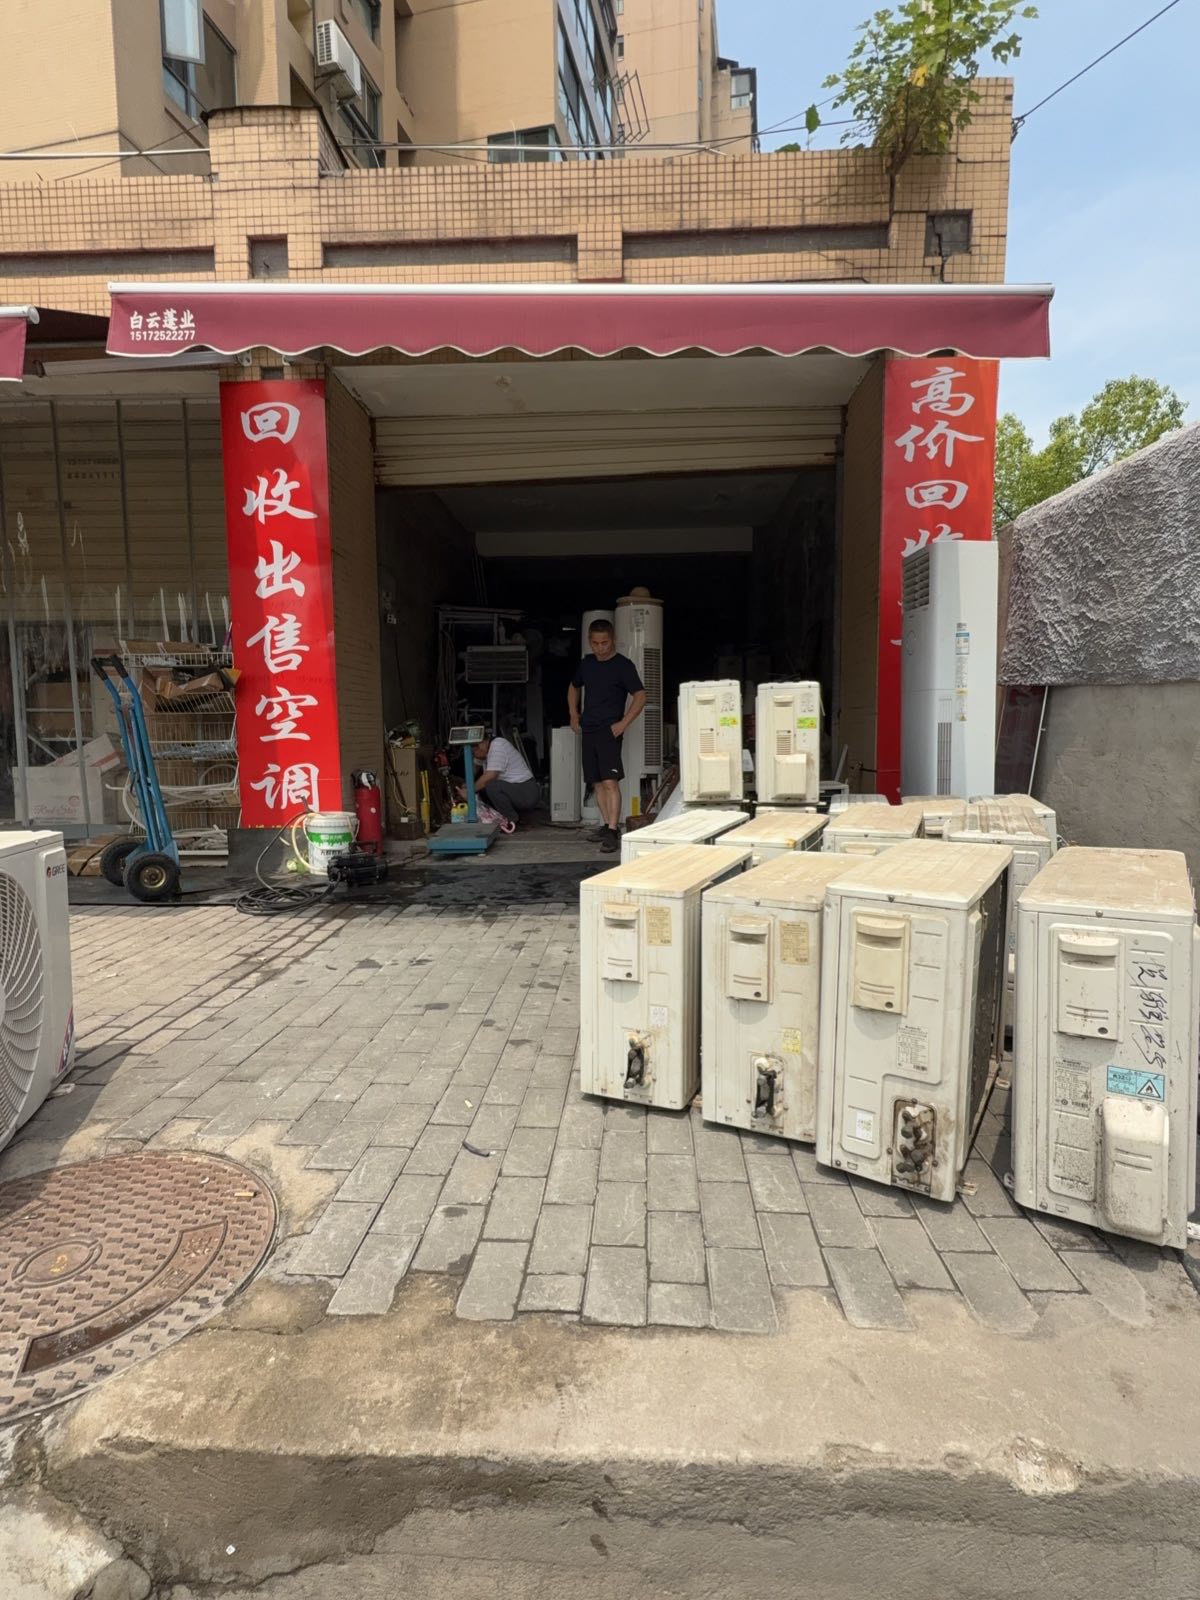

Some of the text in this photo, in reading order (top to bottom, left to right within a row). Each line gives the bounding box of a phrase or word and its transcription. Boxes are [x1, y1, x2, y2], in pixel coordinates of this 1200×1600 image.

[130, 330, 195, 341] 15172522277
[241, 401, 320, 812] 回收出售空调
